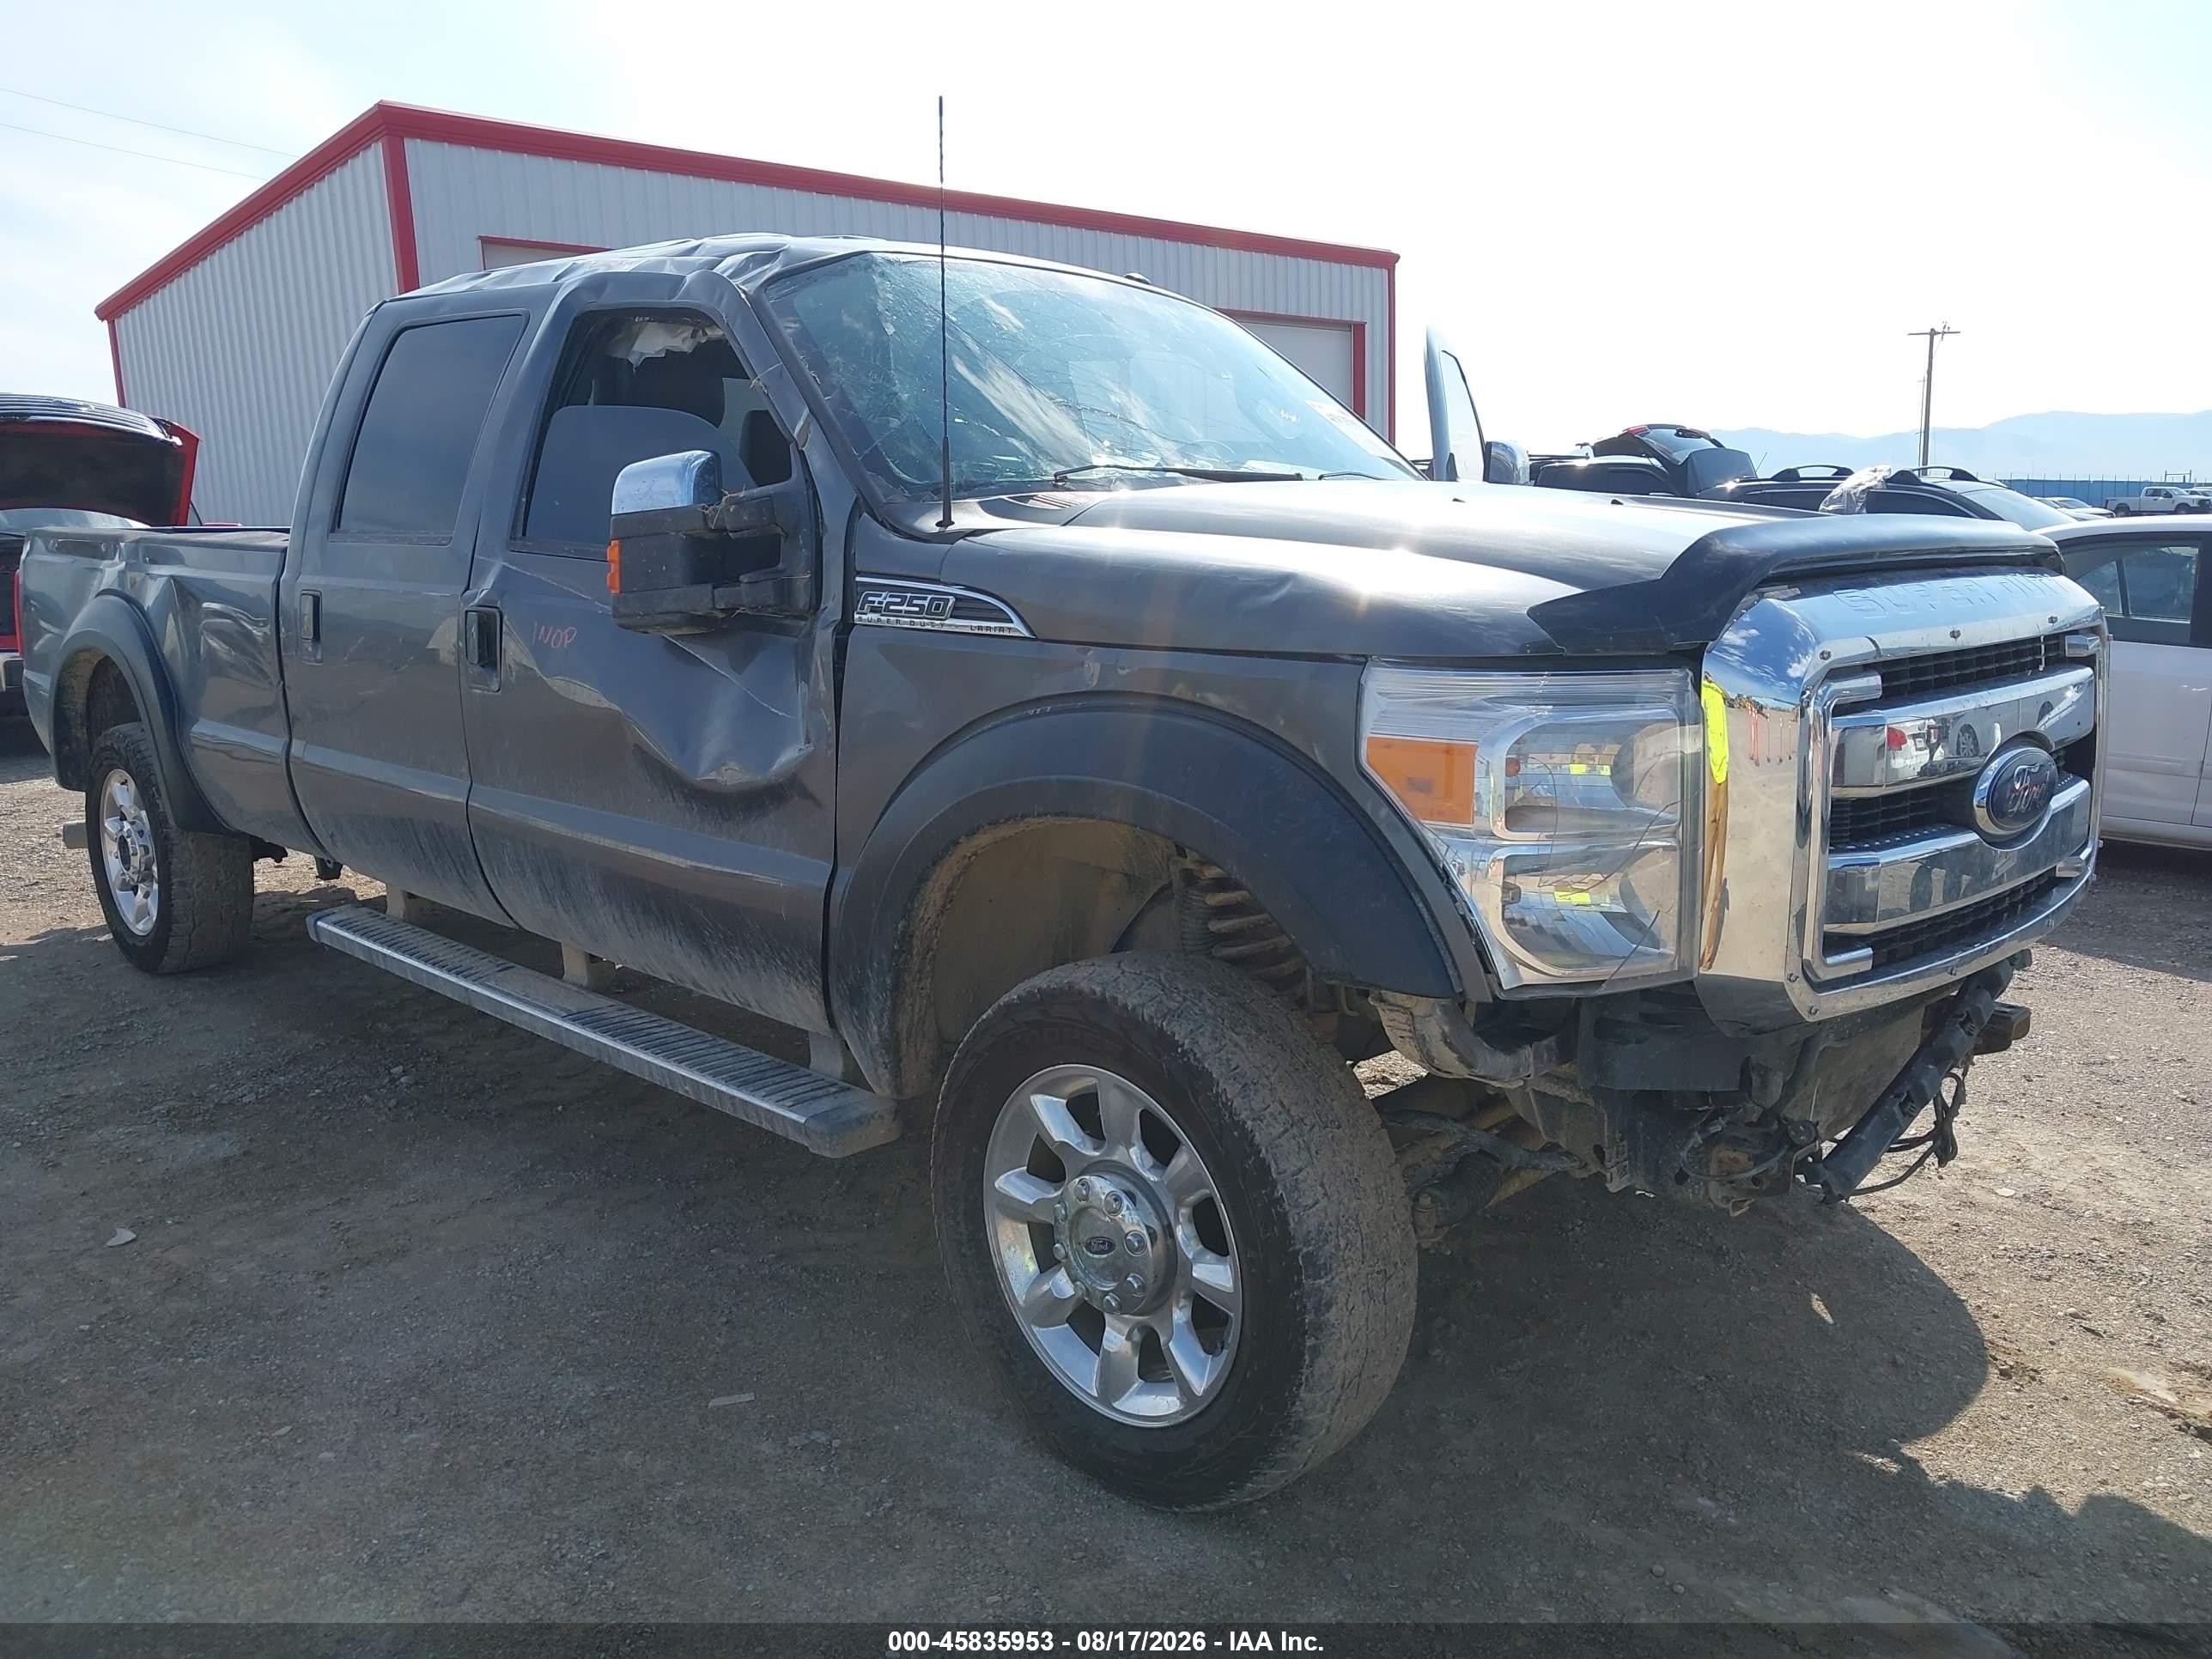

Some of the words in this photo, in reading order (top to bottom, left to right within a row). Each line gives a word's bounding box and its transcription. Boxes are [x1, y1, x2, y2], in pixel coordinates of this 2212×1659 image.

[858, 591, 955, 621] F-250
[532, 621, 578, 649] INOP
[858, 617, 902, 626] SUPER
[908, 620, 945, 629] DUTY
[969, 625, 1013, 634] LARIAT
[2007, 763, 2051, 817] Ford
